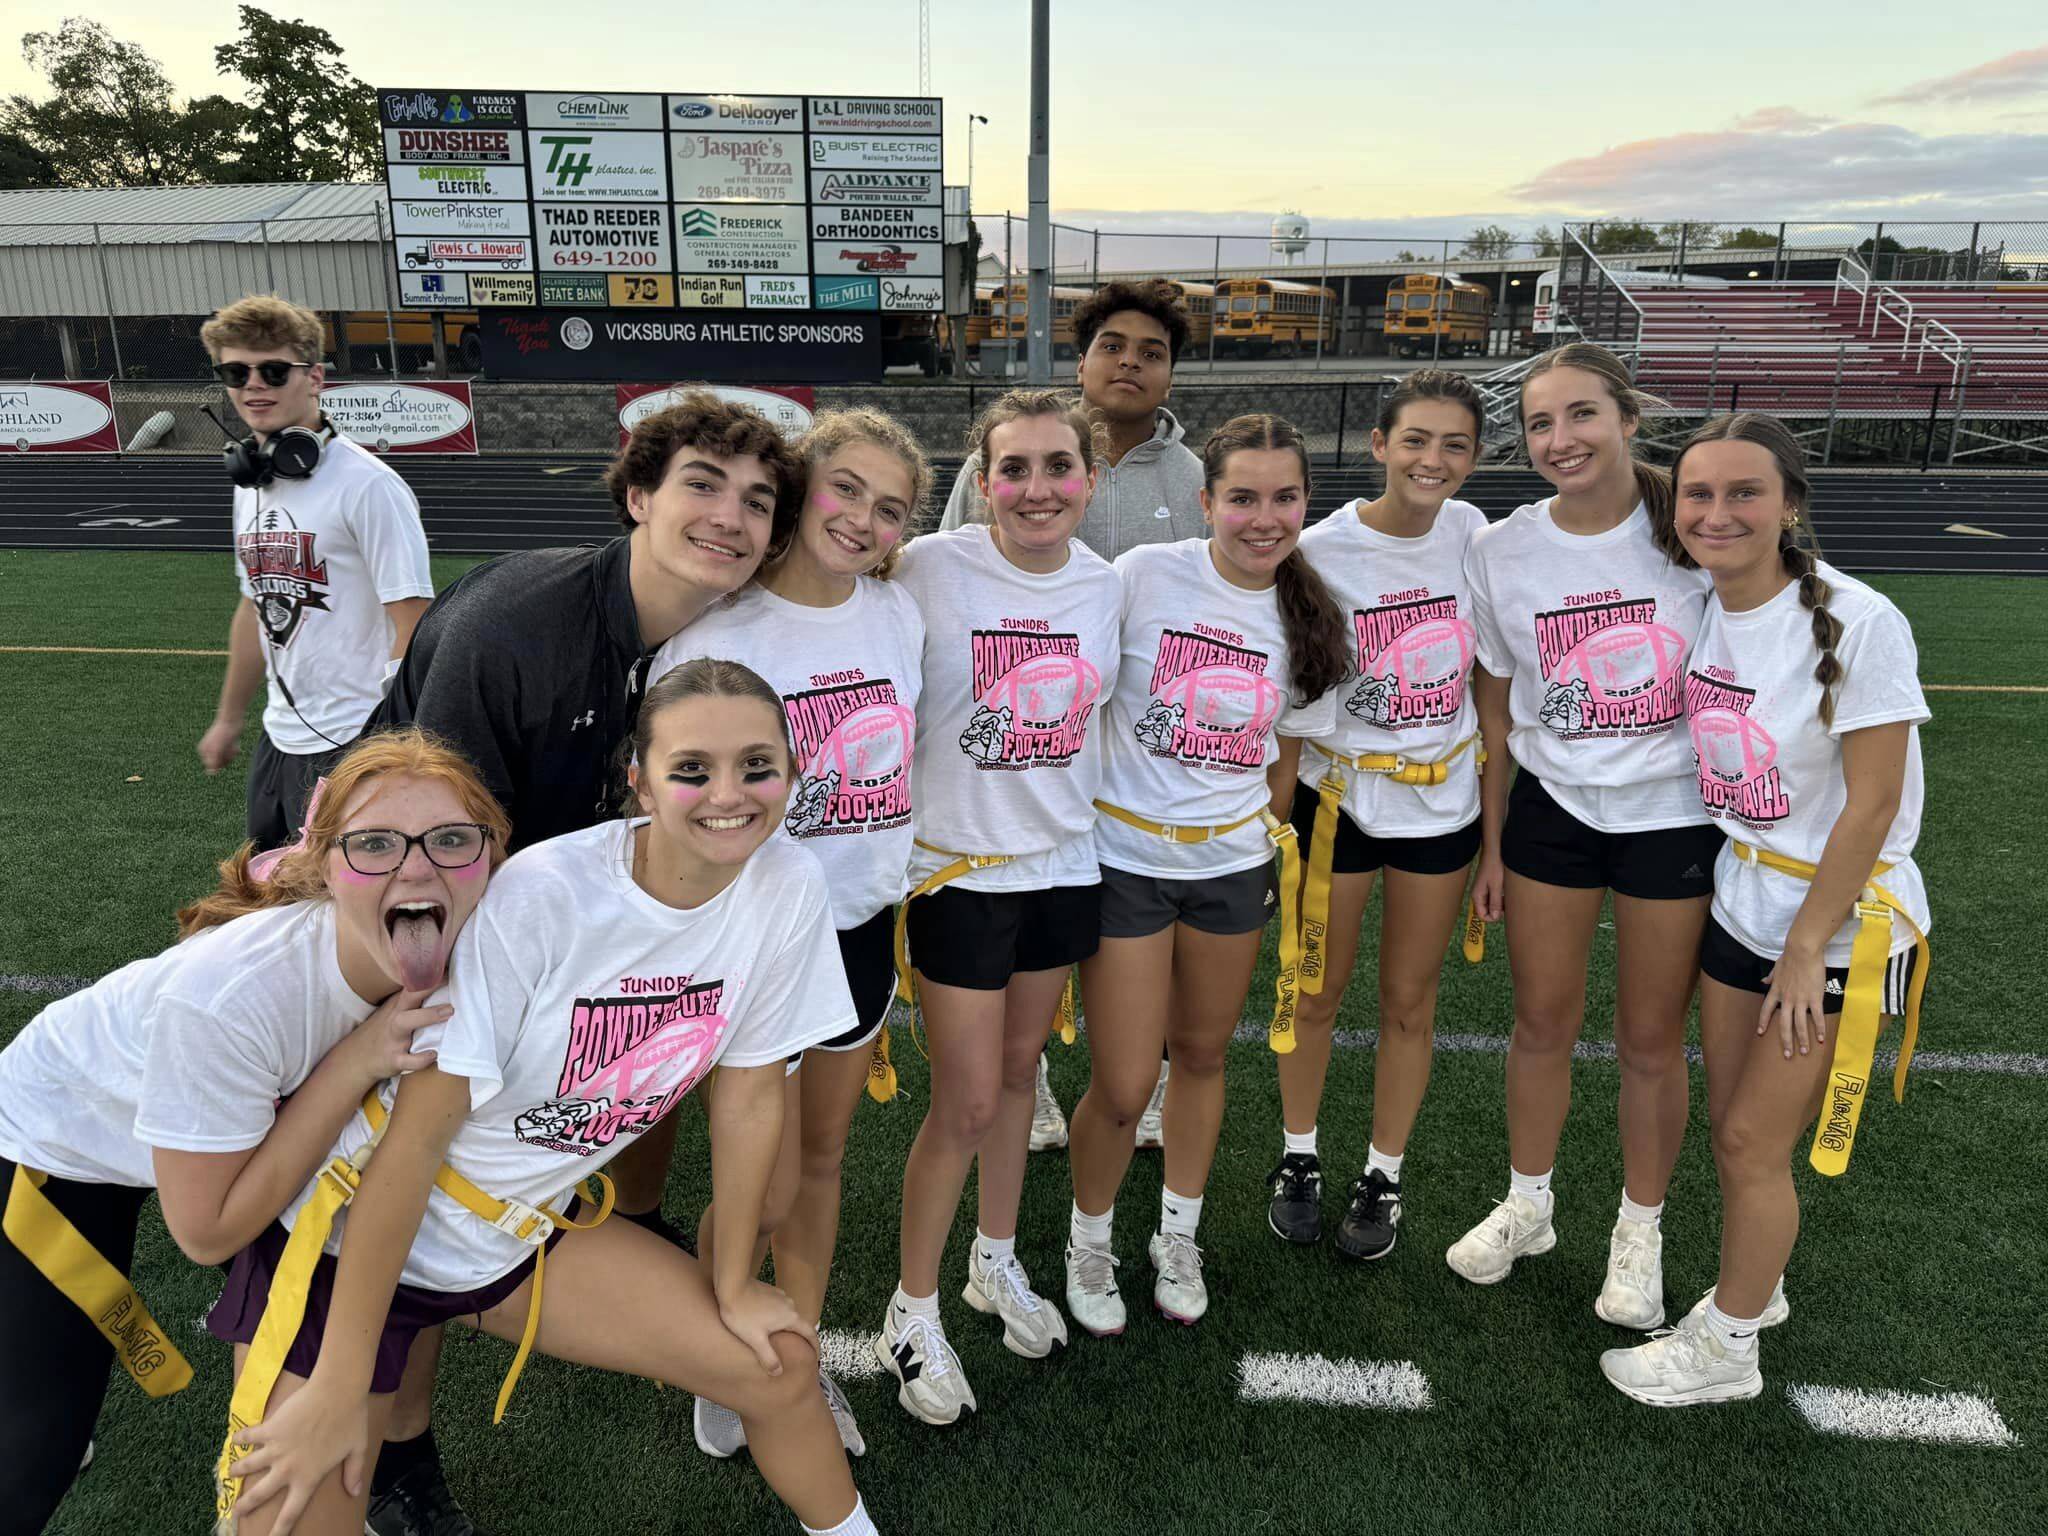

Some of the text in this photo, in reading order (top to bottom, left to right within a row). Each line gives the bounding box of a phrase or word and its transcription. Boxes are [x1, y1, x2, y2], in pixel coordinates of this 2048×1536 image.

[473, 96, 517, 105] KINDNESS
[557, 101, 630, 115] CHEM LINK
[813, 101, 937, 116] L&L DRIVING SCHOOL
[477, 105, 513, 114] IS COOL
[680, 104, 705, 116] Ford
[719, 104, 798, 125] DeNooyer
[398, 131, 510, 152] DUNSHEE
[828, 141, 938, 153] BUIST ELECTRIC
[739, 157, 793, 177] Pizza
[697, 185, 786, 199] 269-649-3975
[402, 203, 504, 218] TowerPinkster
[542, 209, 660, 226] THAD REEDER
[841, 209, 914, 222] BANDEEN
[720, 217, 783, 229] FREDERICK
[549, 229, 659, 247] AUTOMOTIVE
[816, 225, 939, 239] ORTHODONTICS
[433, 243, 523, 254] Lewis C. Howard
[732, 250, 791, 258] CONTRACTORS
[752, 242, 797, 250] MANAGERS
[553, 251, 657, 266] 649-1200
[472, 277, 532, 290] Willmeng
[681, 278, 742, 291] Indian Run
[760, 281, 796, 292] FRED'S
[491, 291, 534, 304] Family
[543, 288, 605, 301] STATE BANK
[701, 292, 724, 305] Golf
[750, 294, 807, 305] PHARMACY
[819, 283, 875, 304] THE MILL
[882, 281, 941, 309] Johnny's
[605, 323, 864, 343] VICKSBURG ATHLETIC SPONSORS
[1379, 587, 1429, 605] JUNIORS
[1563, 589, 1622, 607] JUNIORS
[1000, 618, 1049, 632] JUNIORS
[1192, 622, 1244, 646] JUNIORS
[1354, 595, 1457, 677] POWDERPUFF
[1535, 598, 1656, 682] POWDERPUFF
[971, 630, 1079, 703] POWDERPUFF
[1150, 628, 1269, 697] POWDERPUFF
[809, 667, 865, 687] JUNIORS
[1604, 677, 1656, 698] 2026
[1388, 679, 1461, 723] FOOTBA
[1579, 664, 1685, 730] FOOTBALL
[782, 679, 898, 776] POWDERPUFF
[1001, 703, 1095, 763] FOOTBALL
[1169, 720, 1273, 768] FOOTBALL
[822, 775, 912, 826] FOOTBA
[1701, 766, 1790, 822] OOTBALL
[556, 979, 724, 1098] POWDERPUFF
